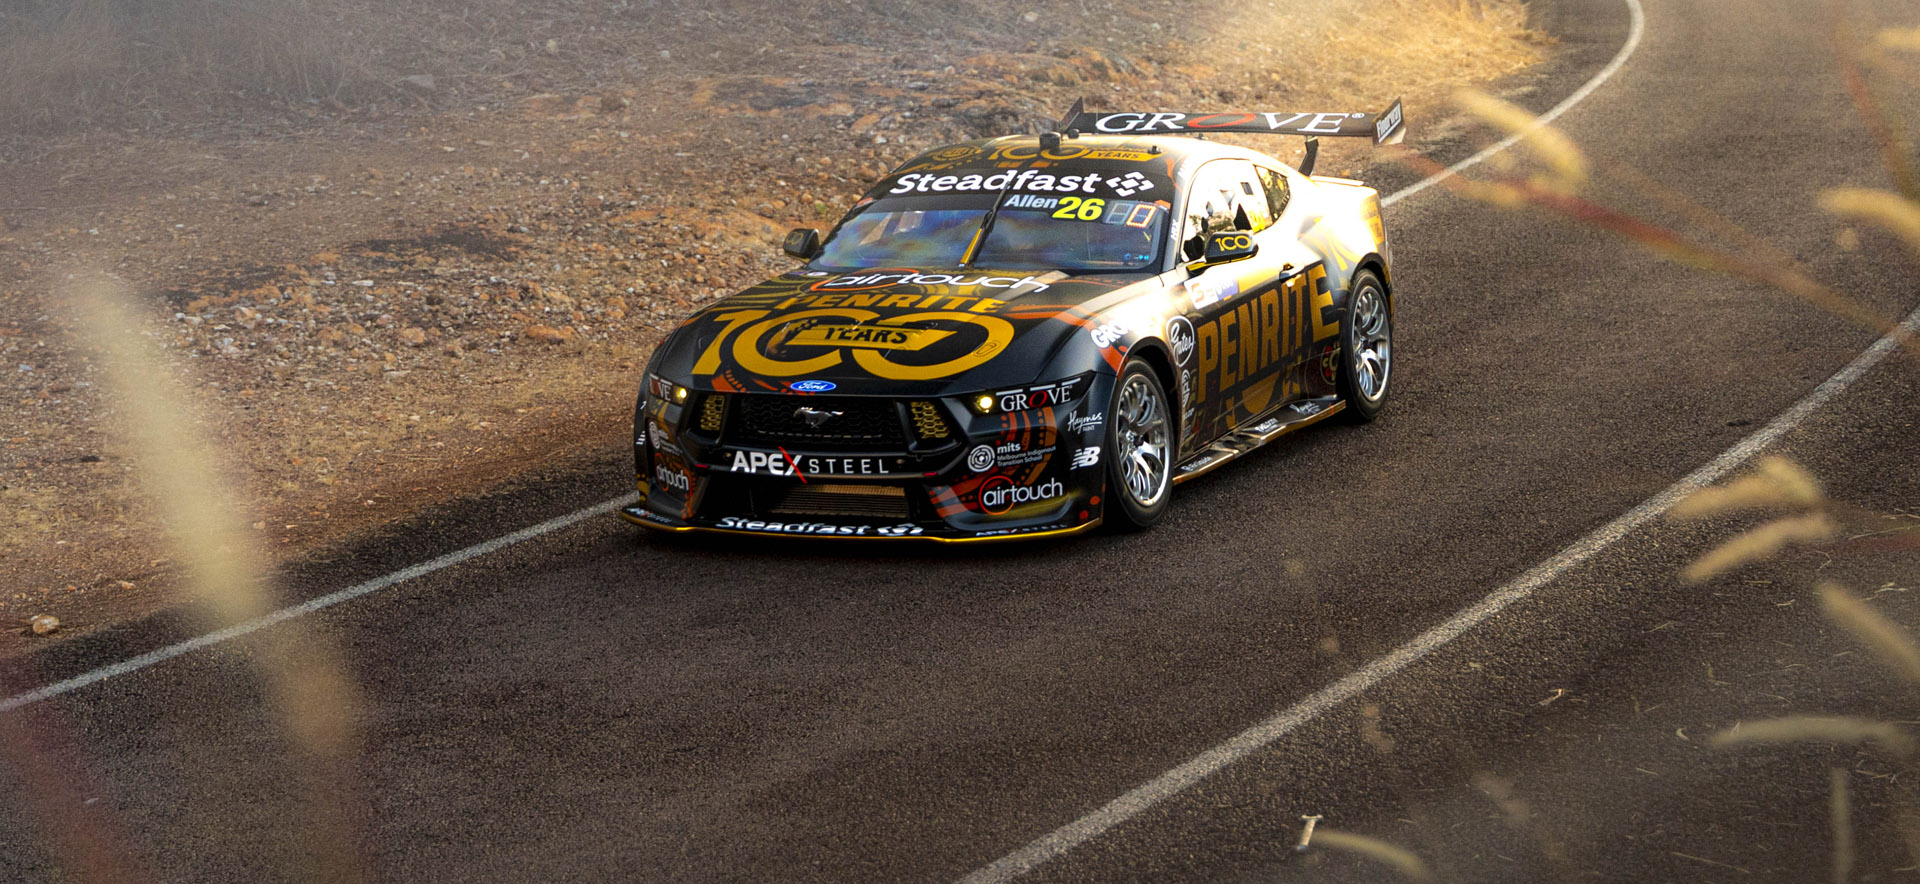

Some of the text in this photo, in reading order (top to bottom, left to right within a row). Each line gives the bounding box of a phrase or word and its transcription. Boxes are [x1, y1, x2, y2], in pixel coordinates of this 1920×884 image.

[1097, 151, 1139, 159] YEARS
[890, 169, 1102, 195] Steadfast
[1004, 194, 1105, 221] Allen 26
[1214, 234, 1251, 252] 100
[824, 273, 1050, 293] airtouch
[775, 293, 1009, 314] PENRITE
[825, 327, 908, 344] YEARS
[1196, 263, 1341, 404] PENRITE
[690, 308, 1015, 380] 100
[798, 382, 827, 391] Ford
[1067, 410, 1103, 435] Haymes
[997, 442, 1021, 454] mits
[997, 445, 1057, 461] Melbourne Indigenous
[731, 449, 889, 479] APEX STEEL
[997, 454, 1043, 467] Transition School
[983, 477, 1063, 506] airtouch
[715, 516, 871, 535] Steadfast
